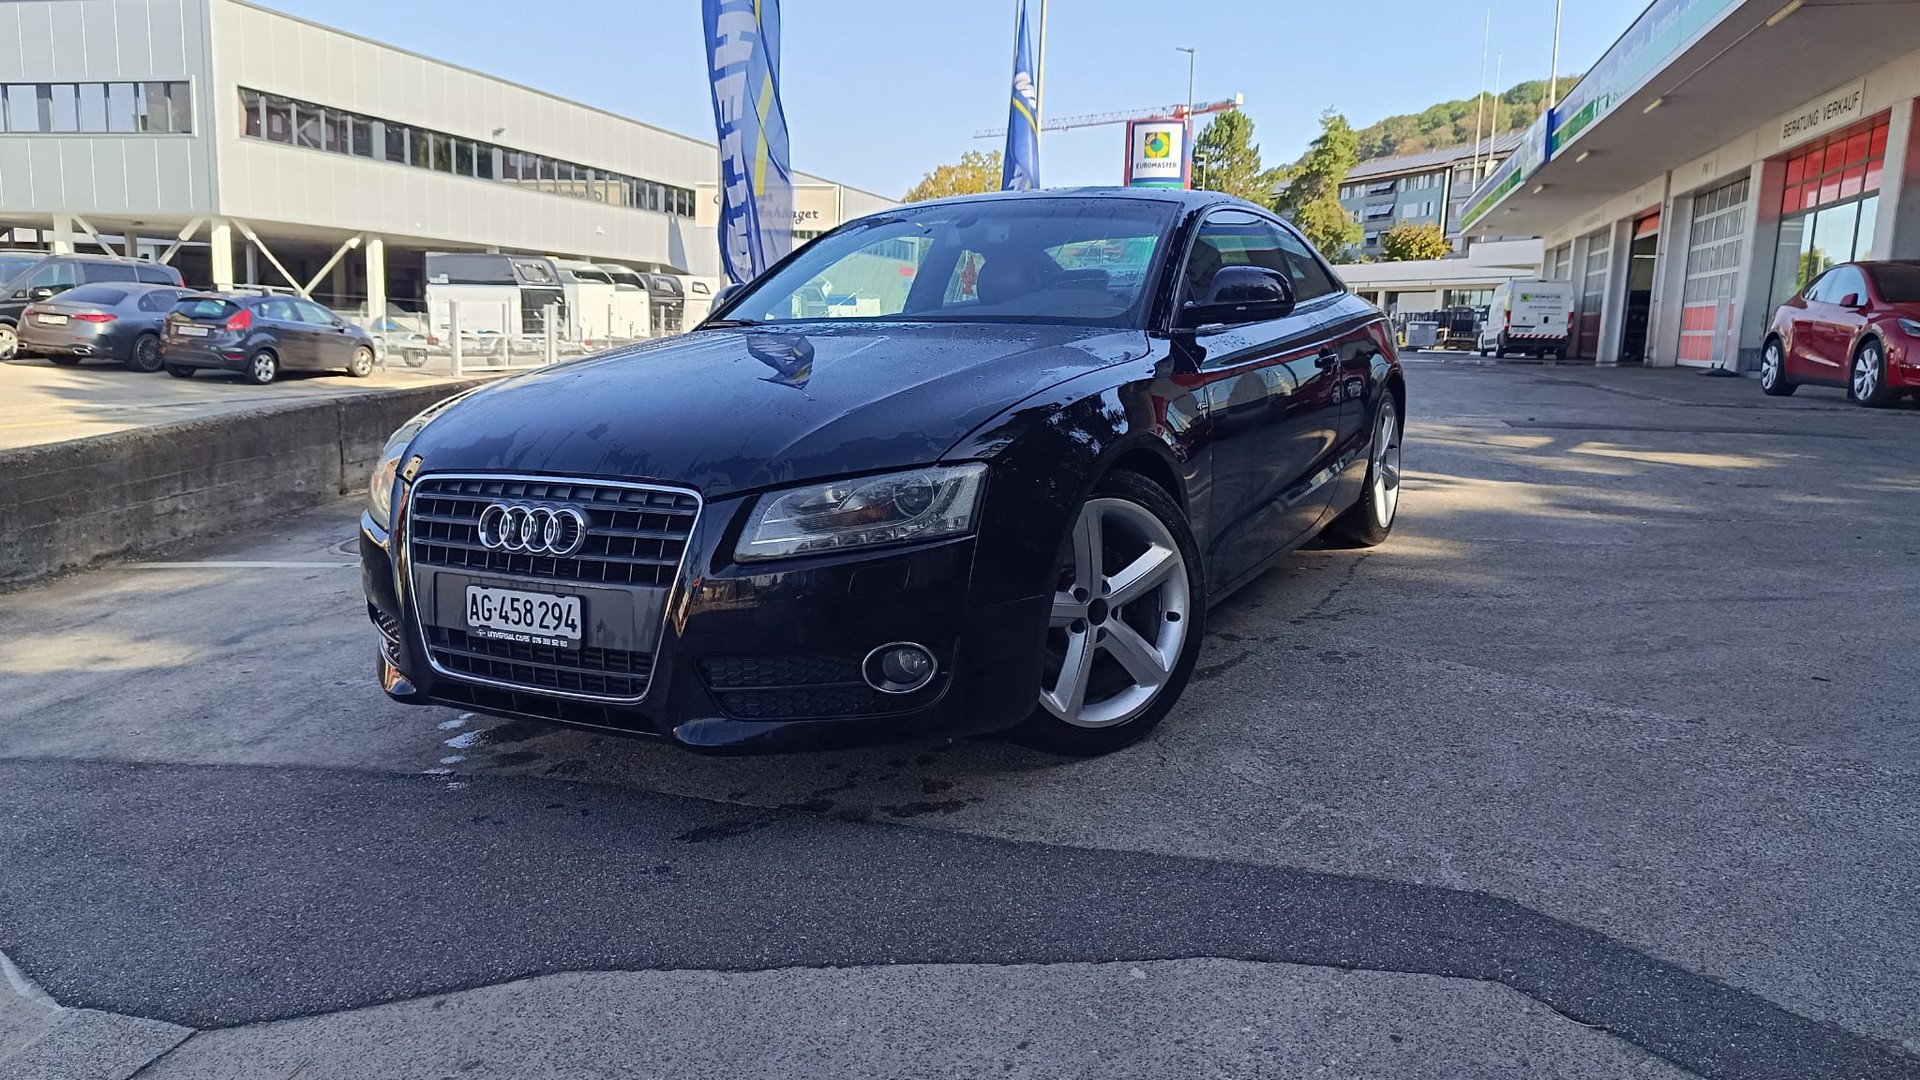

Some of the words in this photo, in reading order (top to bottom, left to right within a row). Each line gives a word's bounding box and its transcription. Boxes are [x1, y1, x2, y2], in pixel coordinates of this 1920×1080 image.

[1783, 109, 1819, 139] BERATUNG
[1822, 90, 1860, 120] VERKAUF
[1136, 162, 1177, 170] EUROMASTER
[487, 630, 515, 641] UNIVERSAL
[515, 634, 530, 643] CARS
